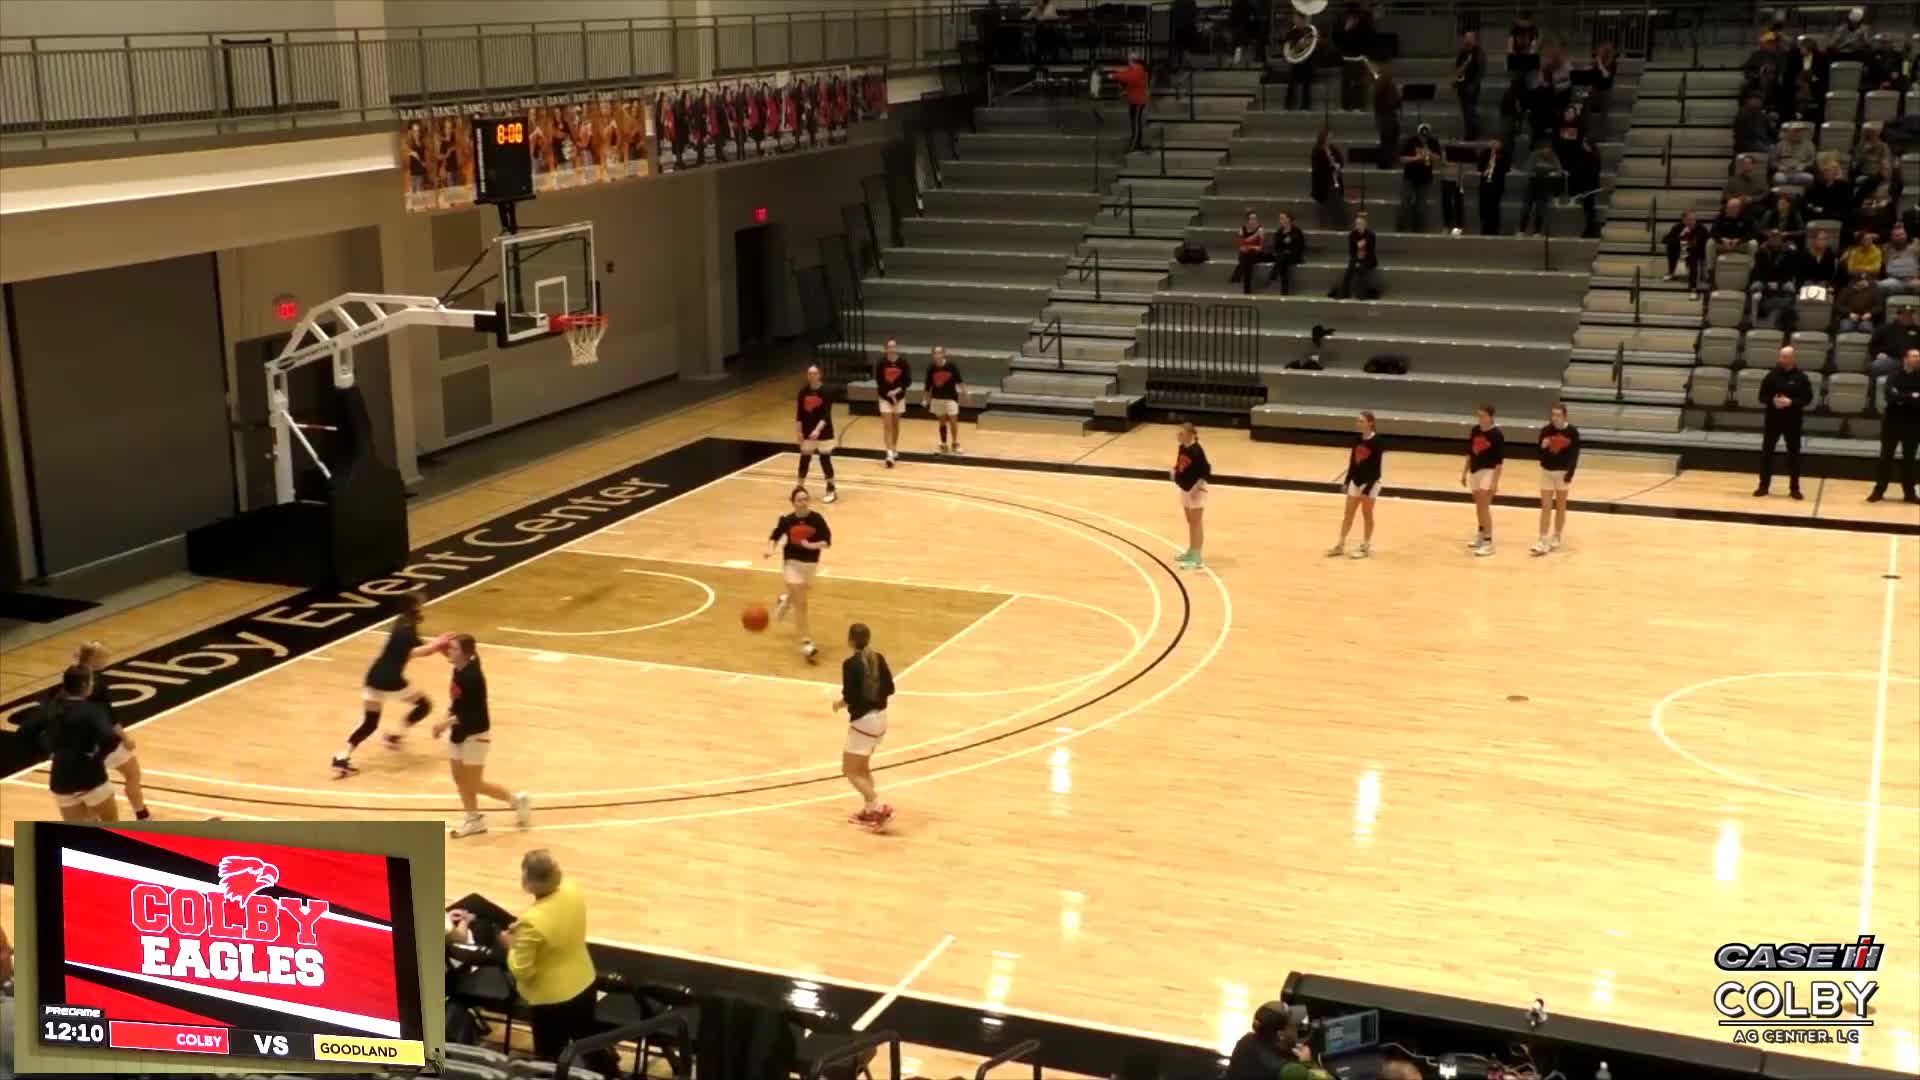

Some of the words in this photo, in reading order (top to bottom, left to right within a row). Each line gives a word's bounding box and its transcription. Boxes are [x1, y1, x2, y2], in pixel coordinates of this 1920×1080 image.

[497, 122, 523, 144] 8:00
[252, 550, 495, 629] Event
[463, 476, 669, 548] Center
[131, 883, 328, 945] COLBY
[140, 935, 325, 987] EAGLES
[45, 1005, 101, 1018] PREGAME
[44, 1021, 104, 1043] 12:10
[176, 1032, 222, 1049] COLBY
[254, 1034, 289, 1056] VS
[320, 1042, 398, 1059] GOODLAND
